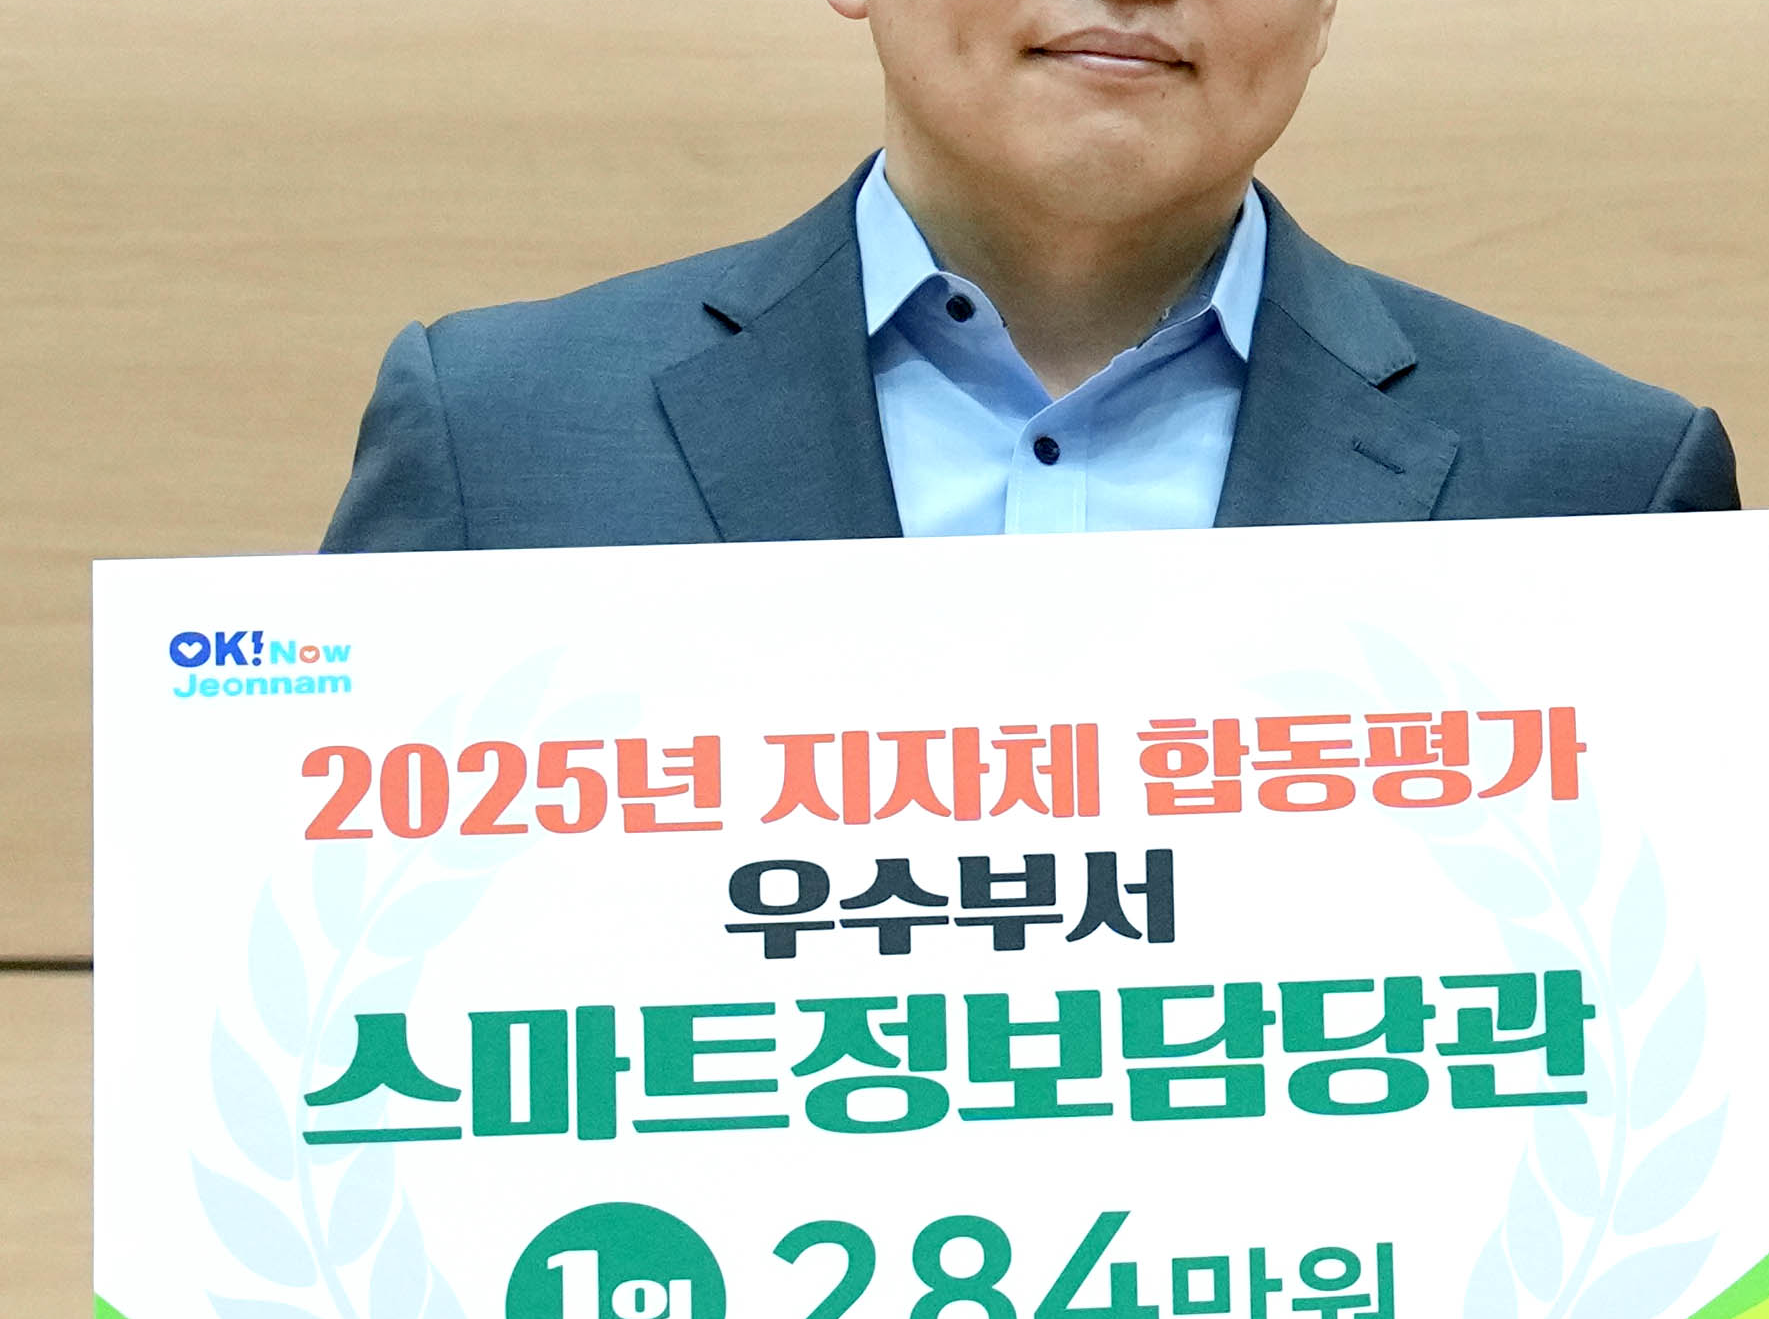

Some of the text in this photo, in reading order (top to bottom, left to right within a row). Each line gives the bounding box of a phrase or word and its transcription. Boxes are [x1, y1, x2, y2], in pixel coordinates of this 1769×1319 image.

[169, 631, 350, 668] OK! Now
[174, 674, 351, 697] Jeonnam
[302, 707, 1586, 840] 2025년 지자체 합동평가
[725, 849, 1175, 959] 우수부서
[302, 969, 1596, 1145] 스마트정보담당관
